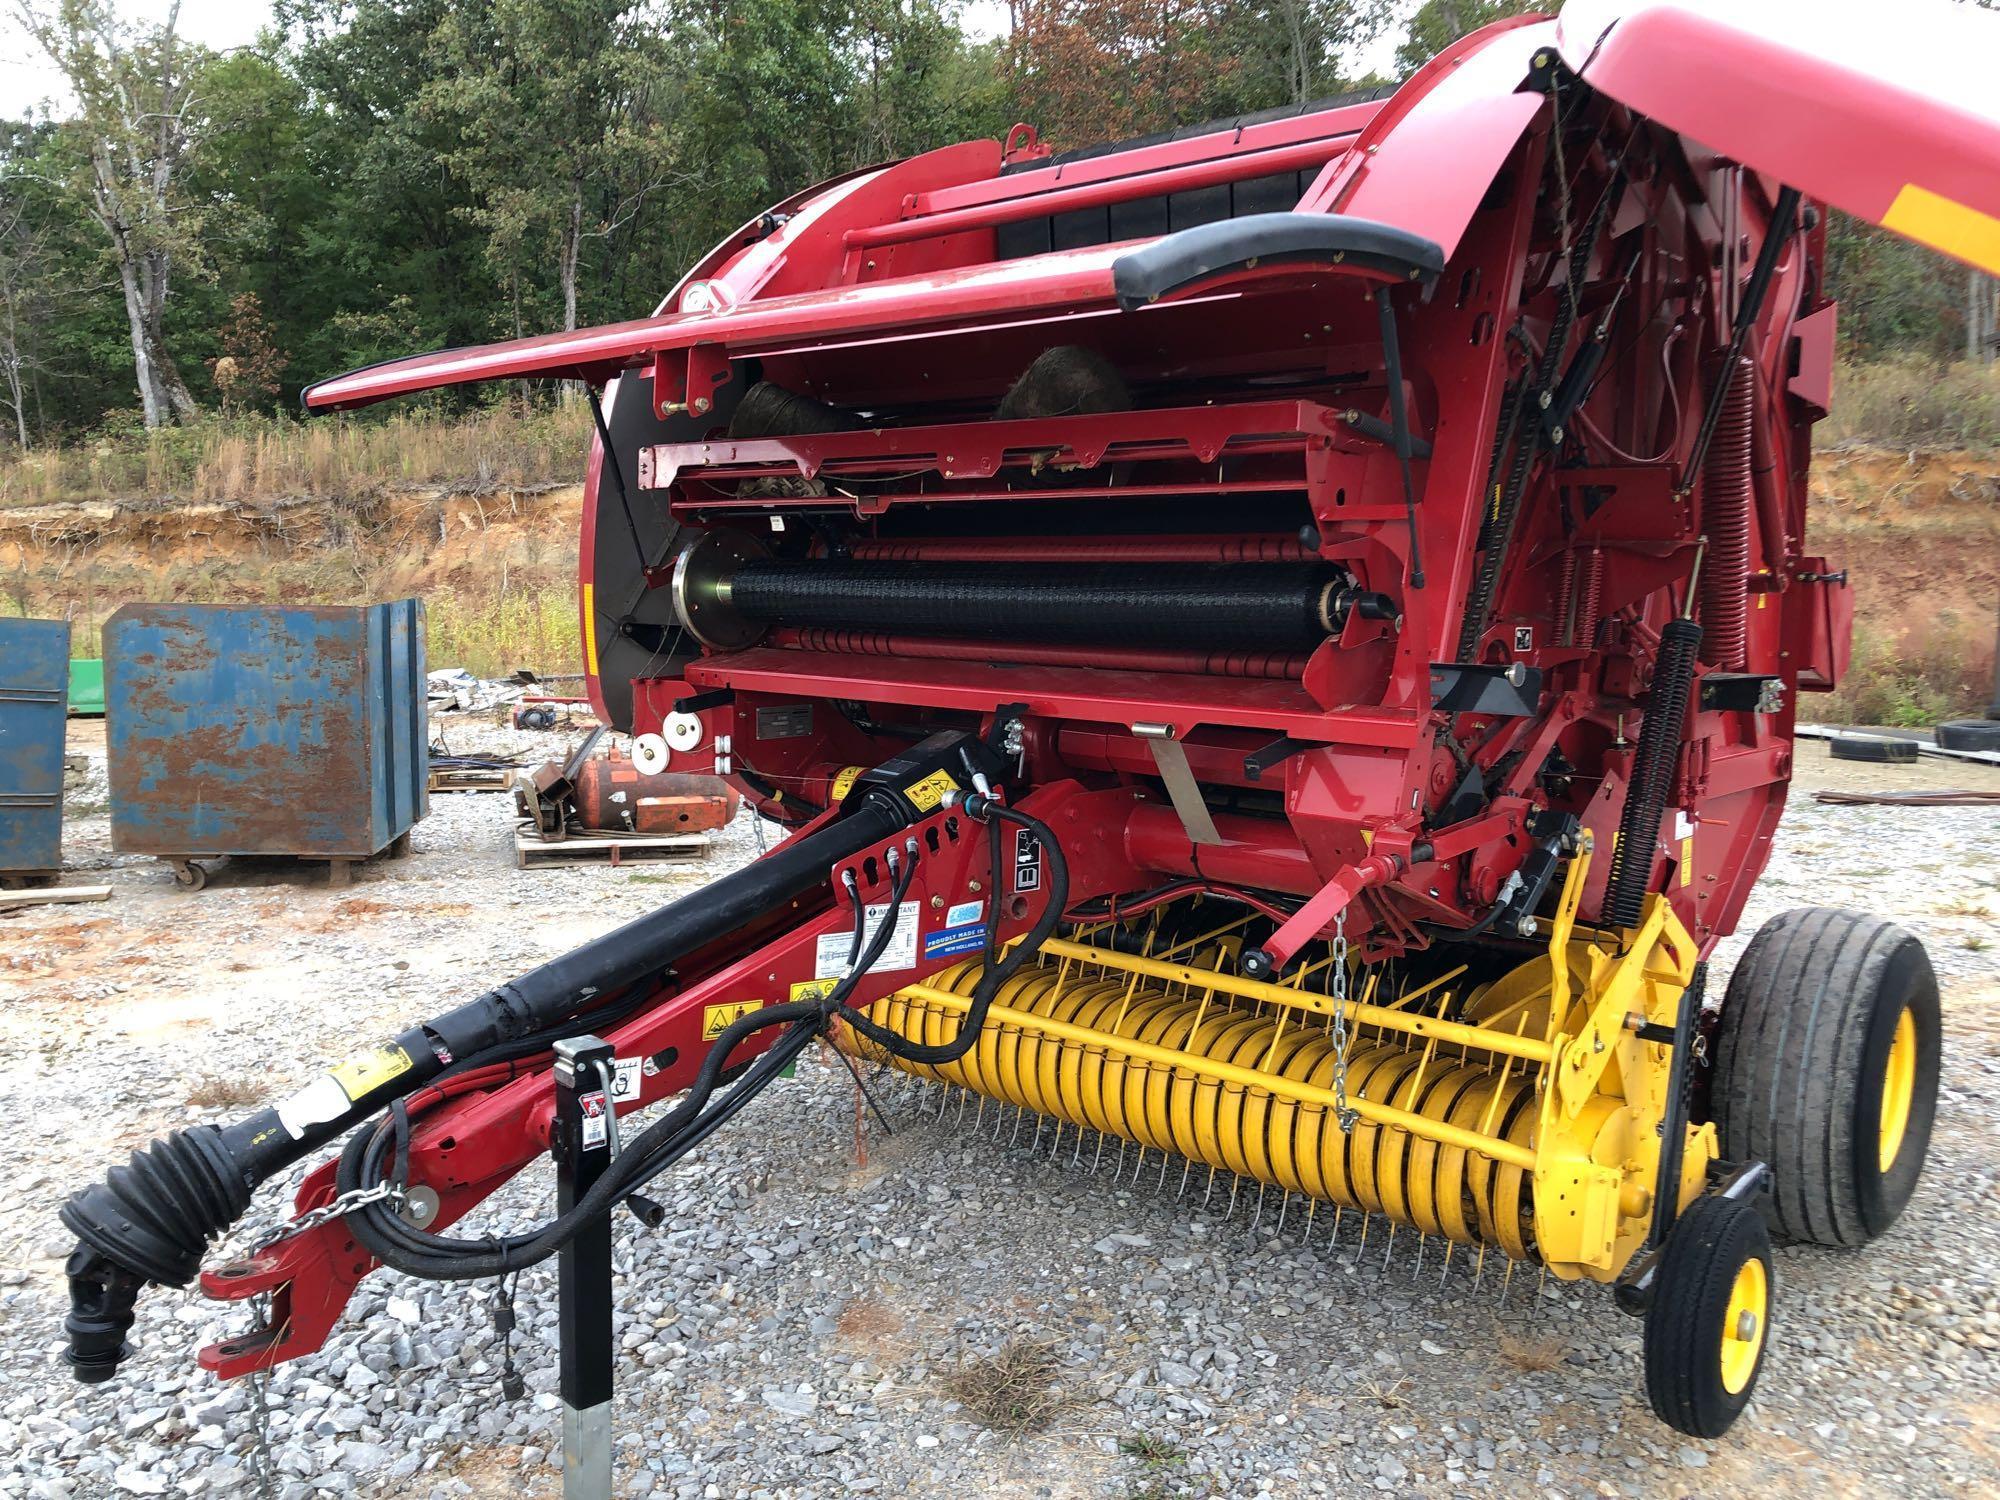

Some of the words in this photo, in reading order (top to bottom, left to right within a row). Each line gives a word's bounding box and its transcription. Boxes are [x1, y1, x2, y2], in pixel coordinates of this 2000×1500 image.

[878, 906, 916, 915] IMTANT
[927, 934, 957, 947] PROUDLY
[958, 929, 976, 938] MADE
